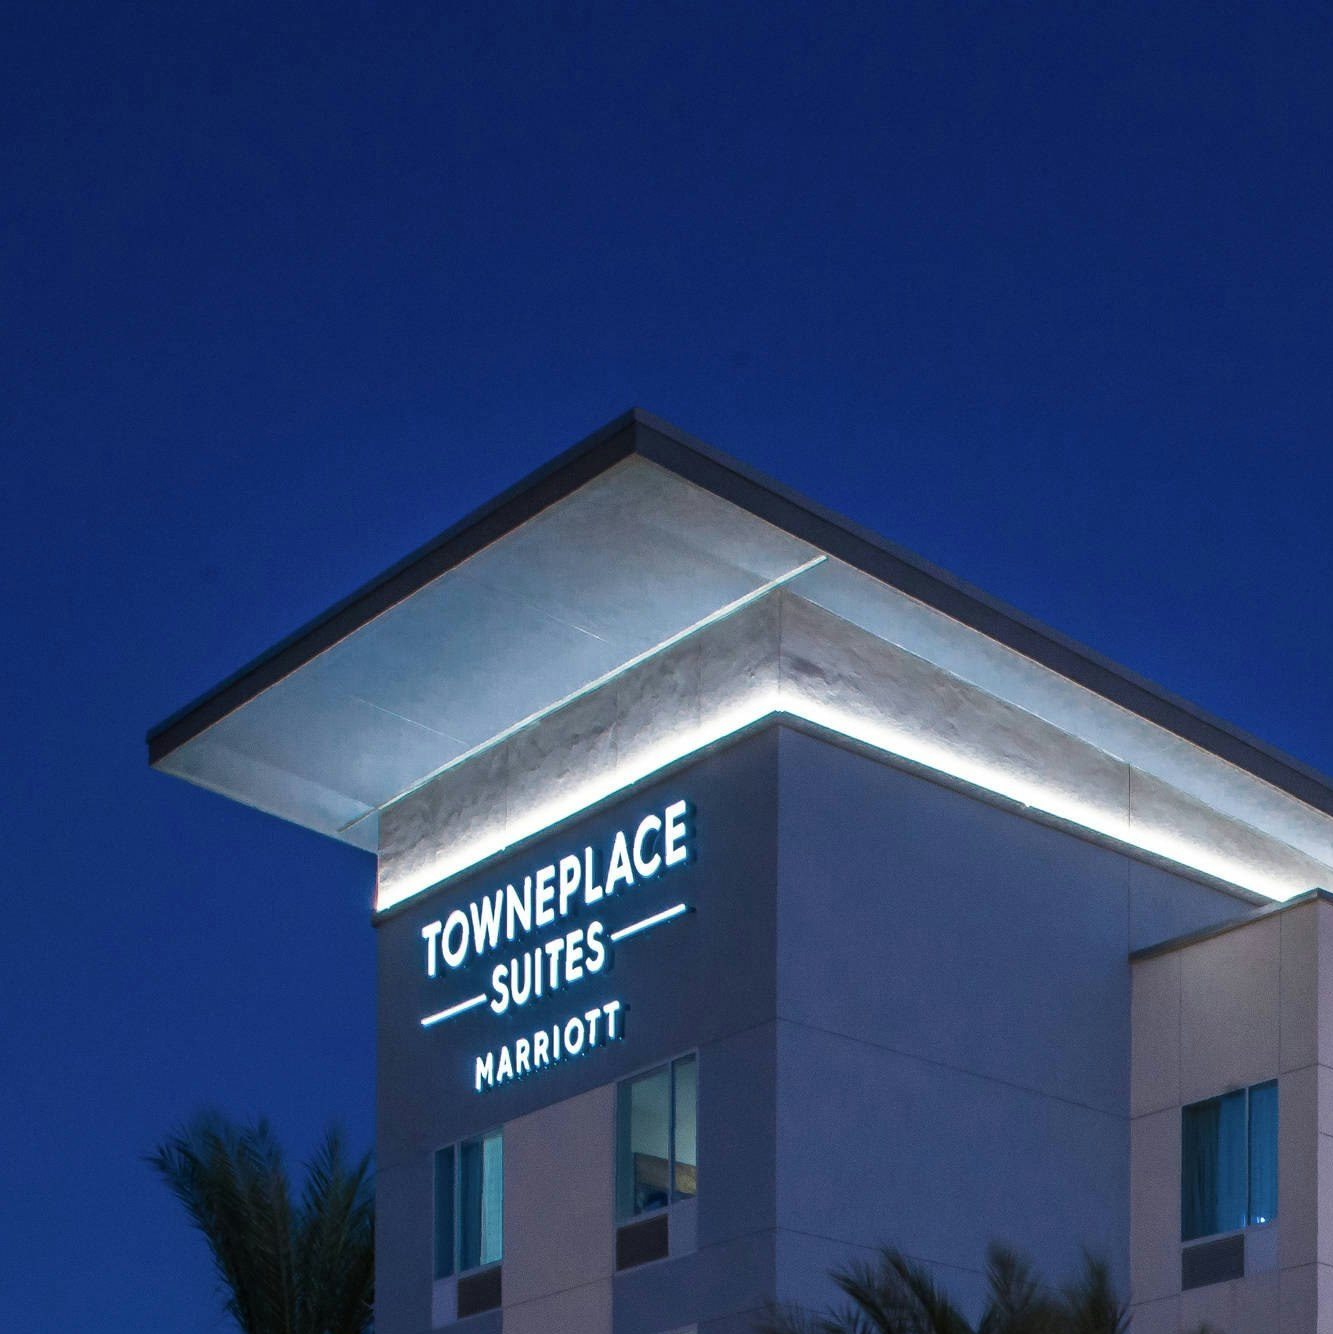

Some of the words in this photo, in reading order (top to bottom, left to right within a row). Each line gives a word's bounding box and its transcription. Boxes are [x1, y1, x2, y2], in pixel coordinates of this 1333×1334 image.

[421, 800, 688, 976] TOWNEPLACE
[490, 920, 606, 1014] SUITES
[474, 1000, 621, 1092] MARRIOTT
